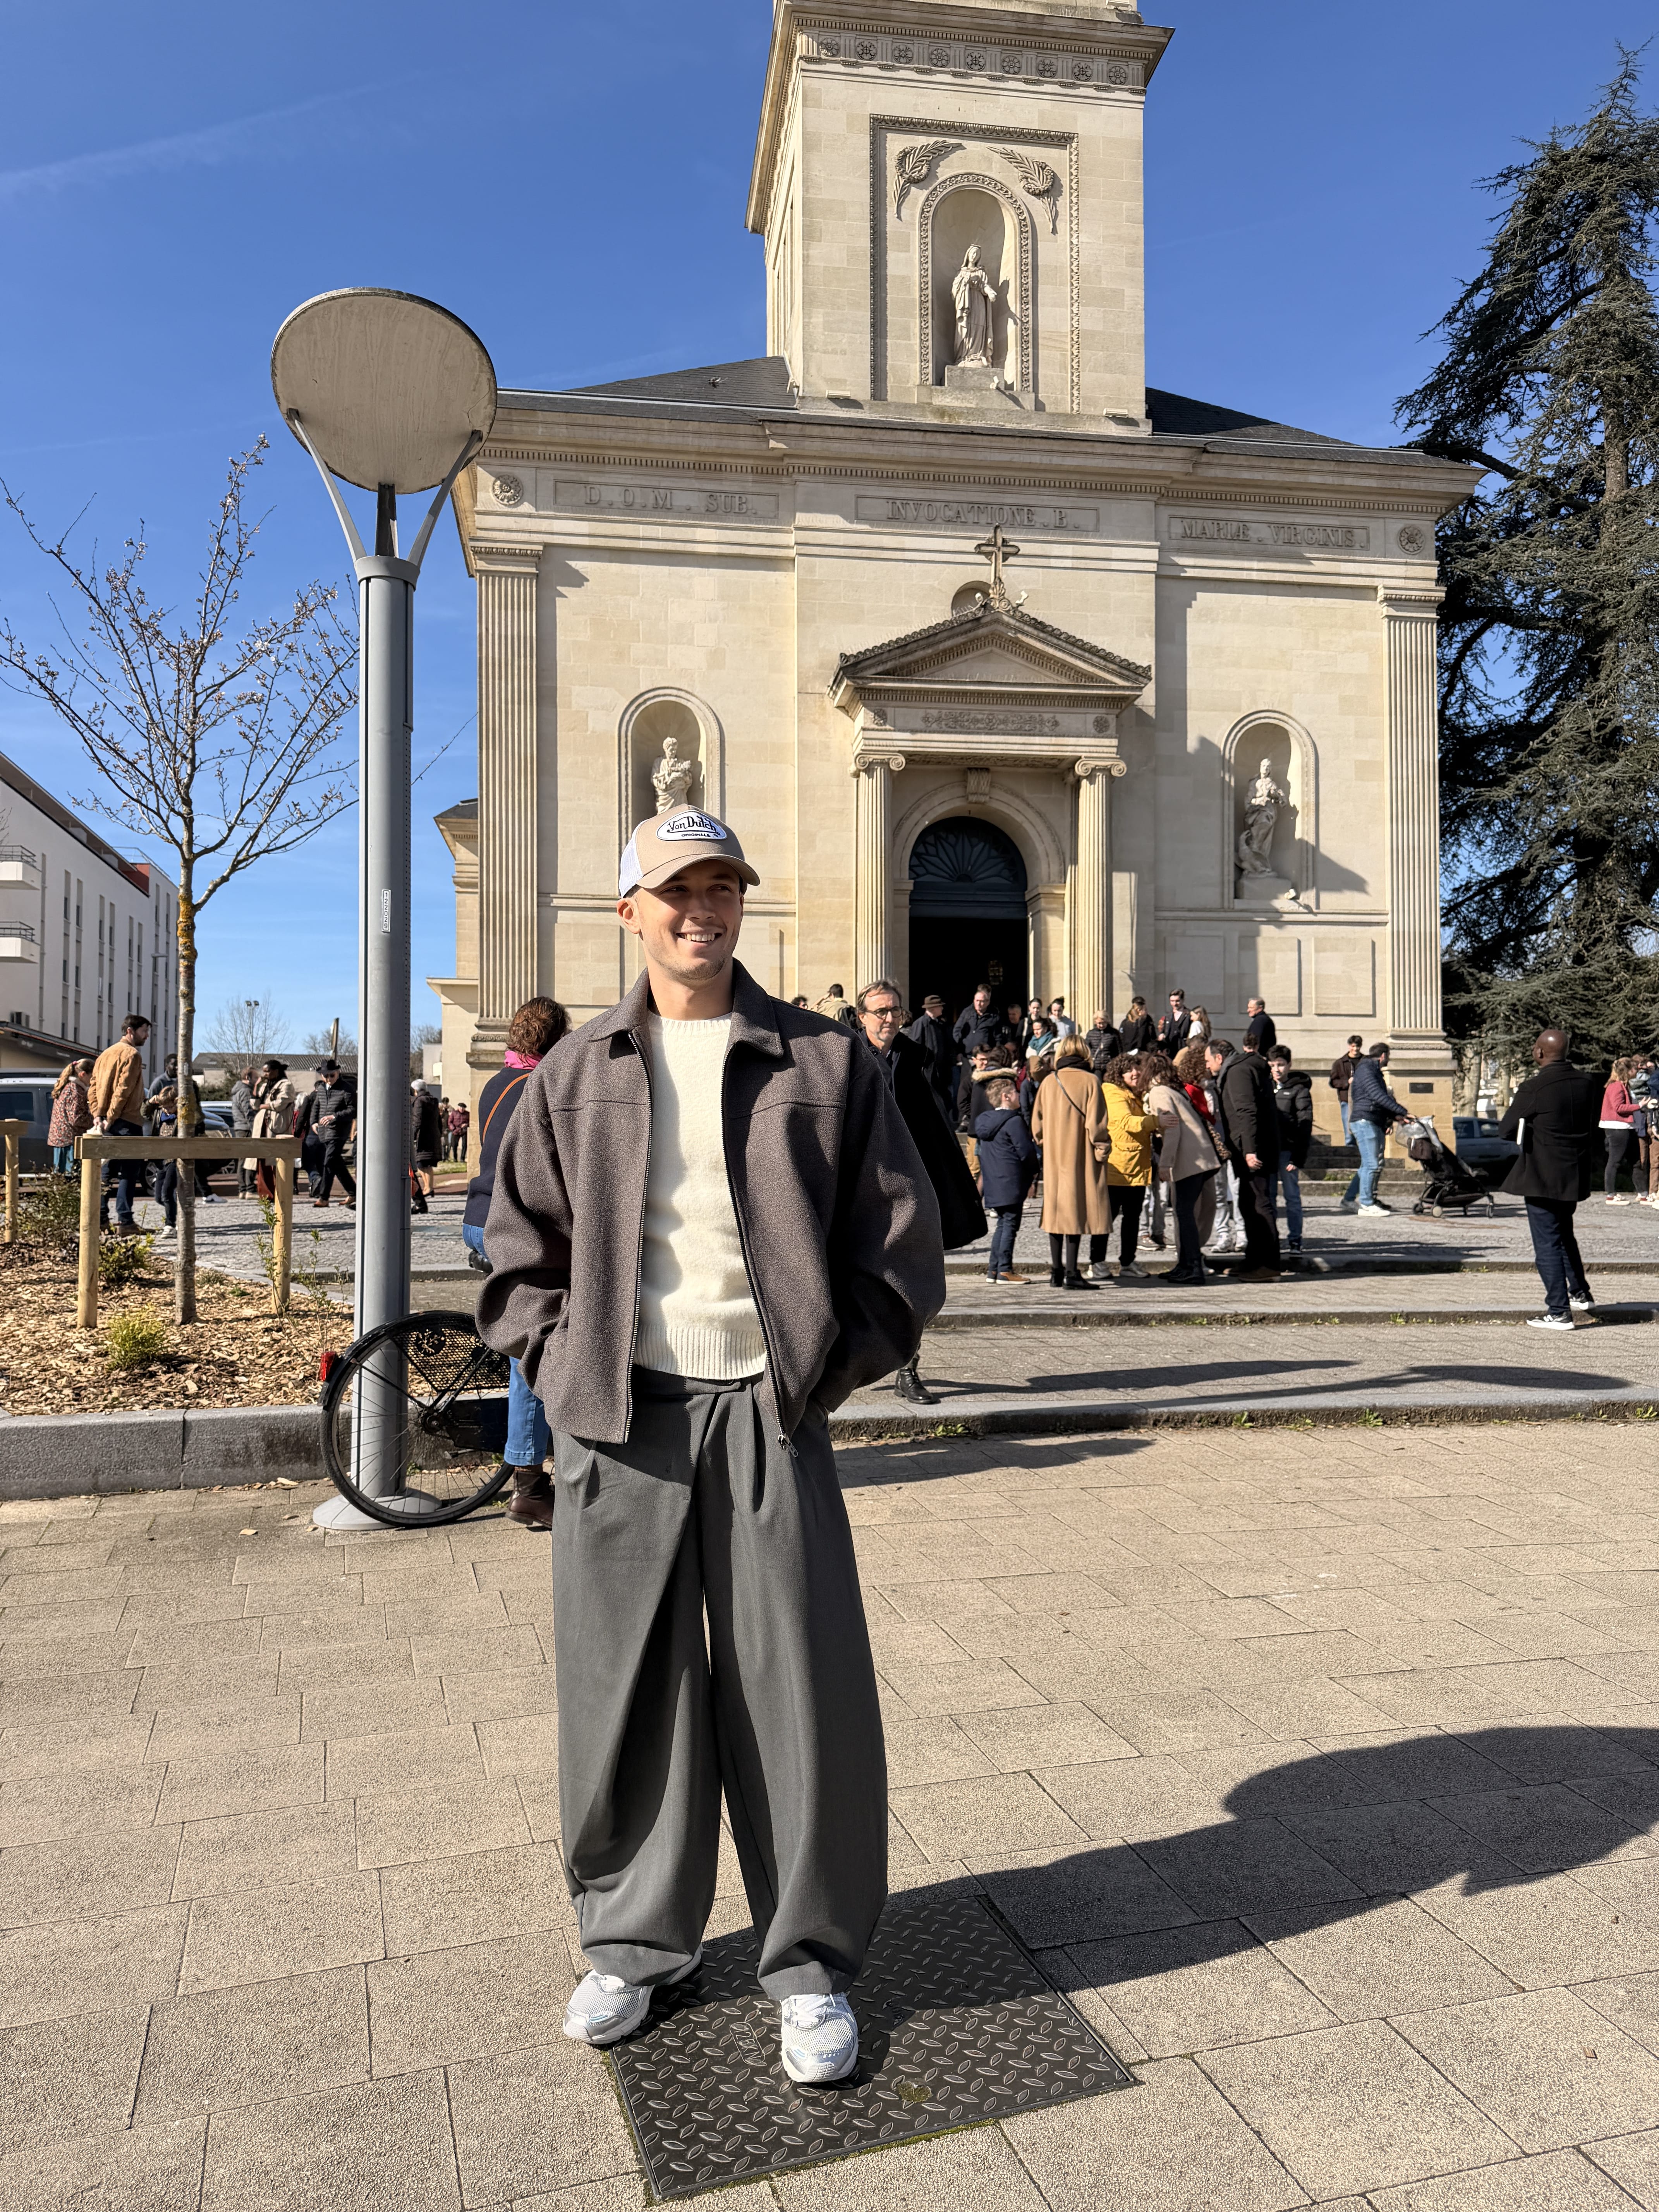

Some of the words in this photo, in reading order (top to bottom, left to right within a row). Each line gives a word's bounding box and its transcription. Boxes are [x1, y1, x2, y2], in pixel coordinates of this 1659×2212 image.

[705, 494, 756, 515] SUB.
[667, 820, 688, 831] Von
[687, 816, 716, 833] Dutch
